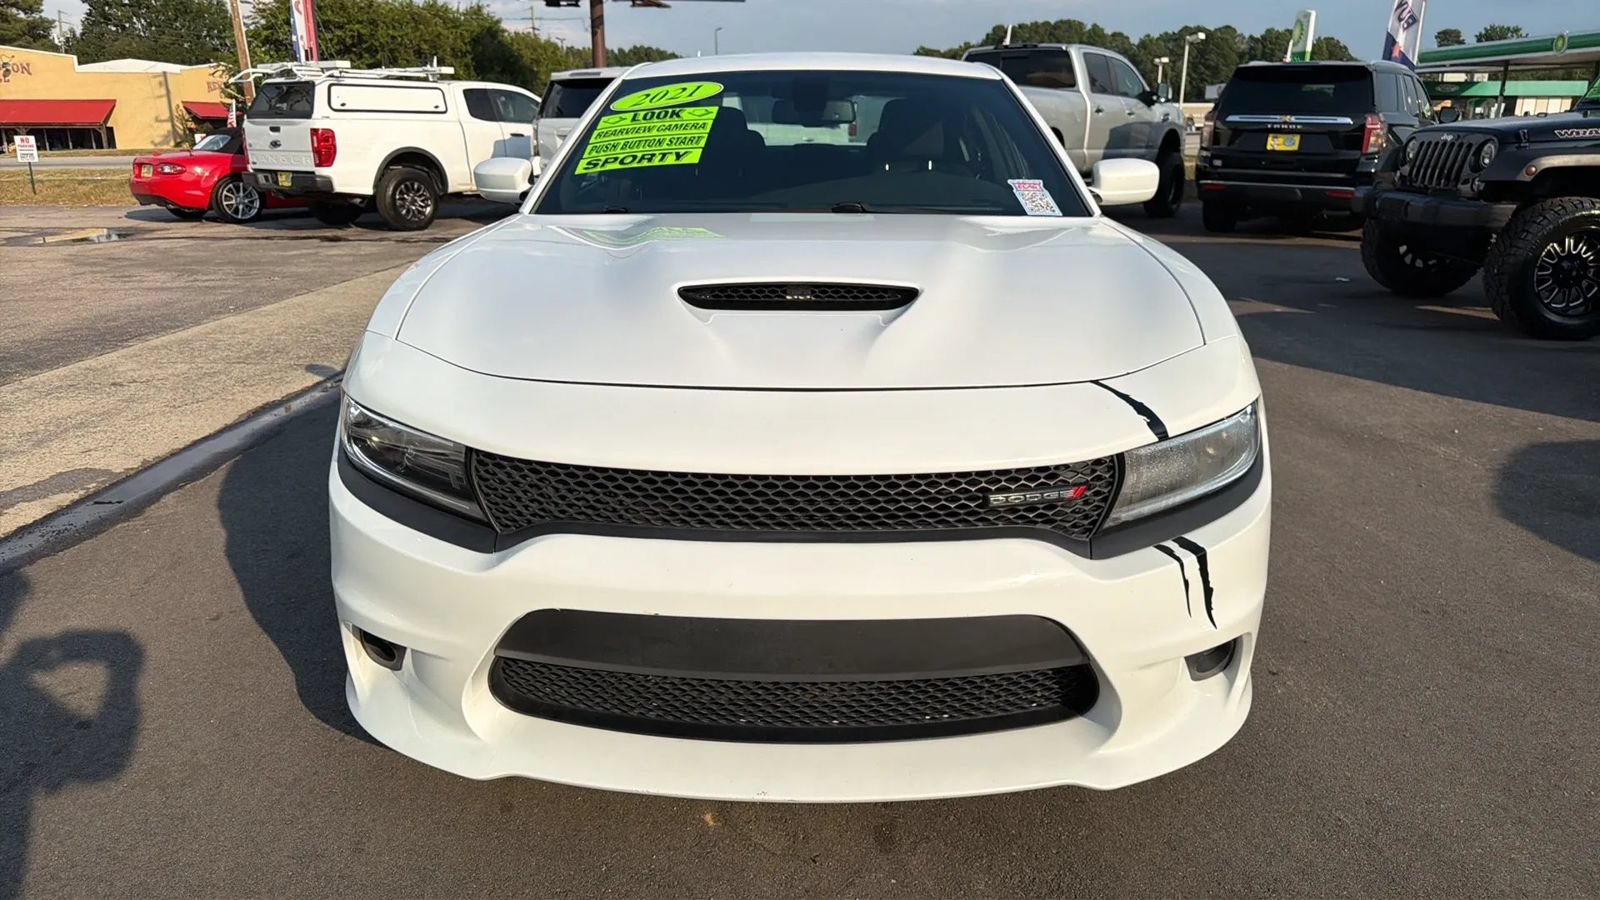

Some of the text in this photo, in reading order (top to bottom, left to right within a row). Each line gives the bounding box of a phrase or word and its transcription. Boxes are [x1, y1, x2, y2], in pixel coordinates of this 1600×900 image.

[629, 85, 704, 107] 2021
[631, 109, 685, 122] LOOK
[594, 122, 708, 140] REARVIEW CAMERA
[588, 134, 704, 155] PUSH BUTTON START
[583, 151, 689, 170] SPORTY
[989, 490, 1074, 505] DODGE
